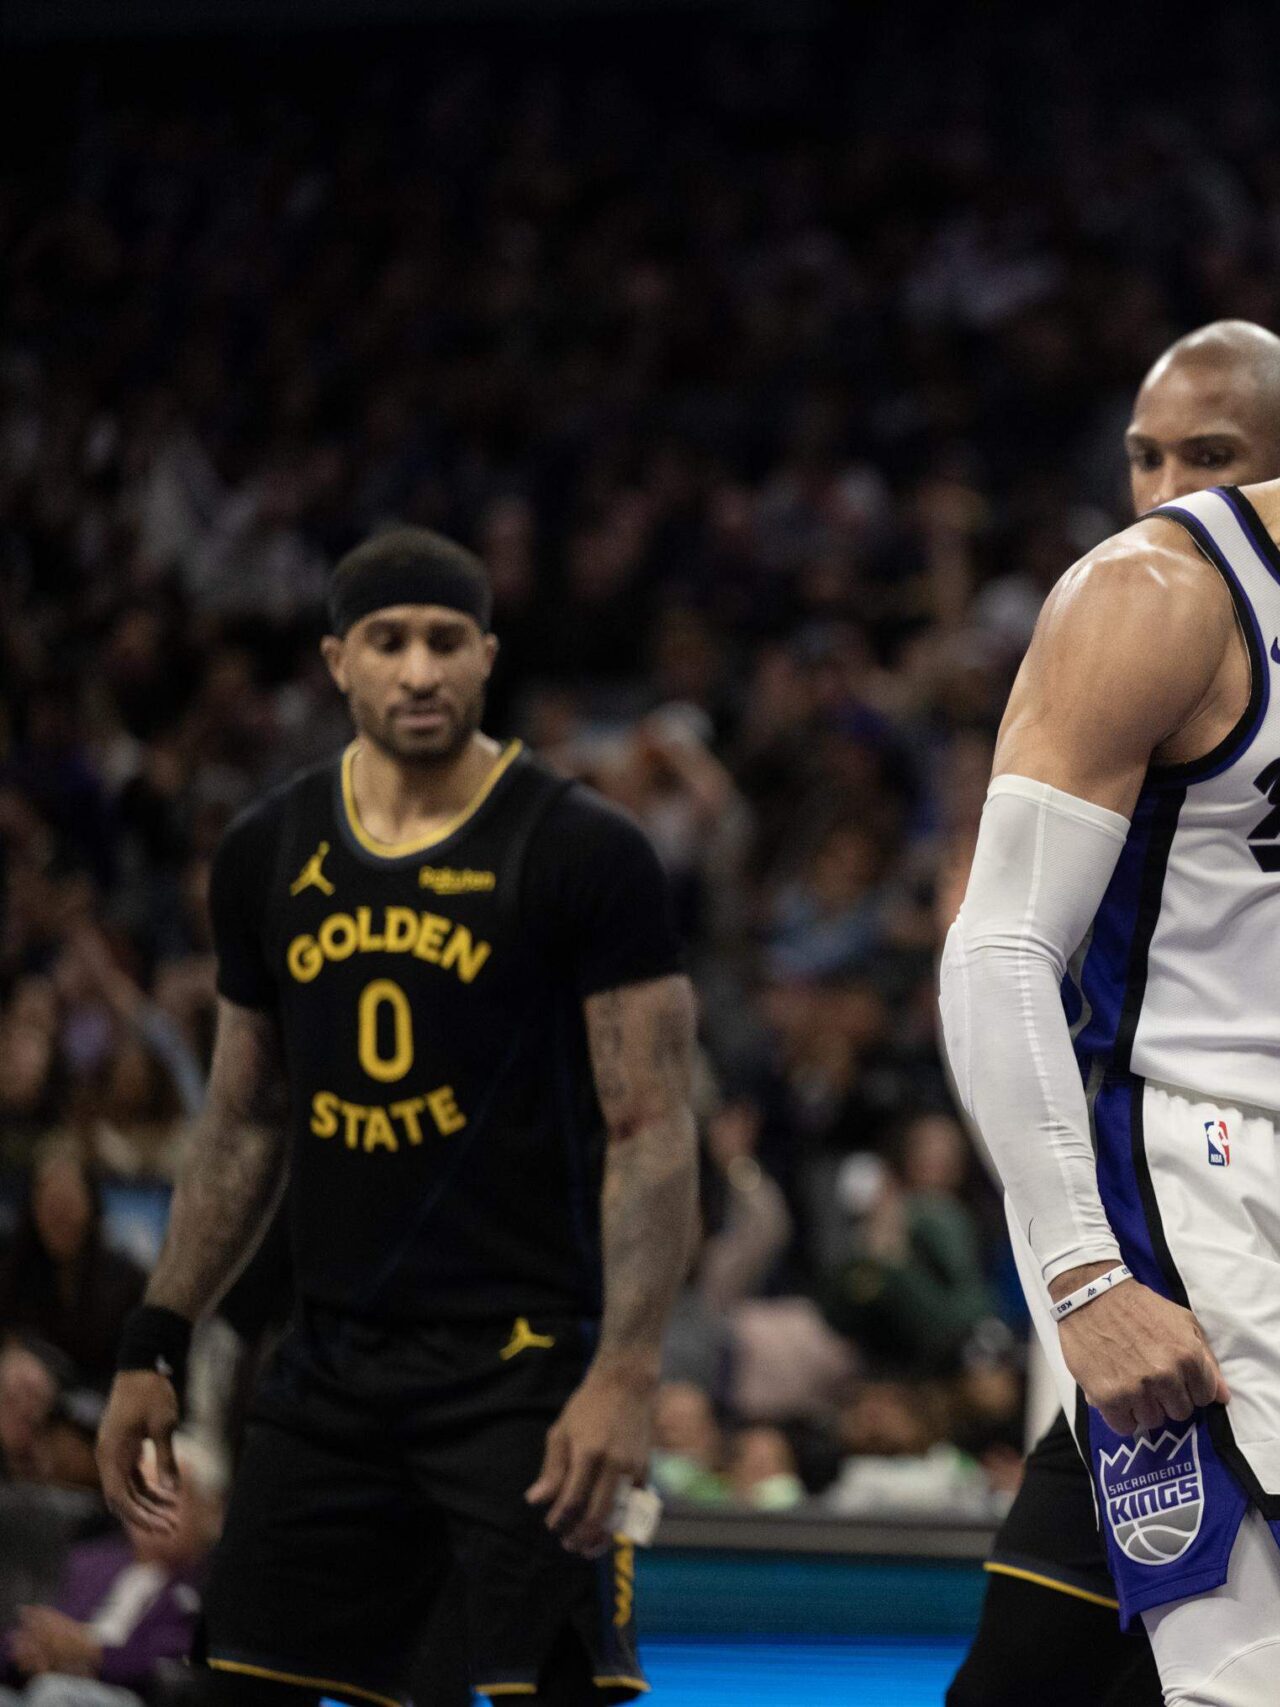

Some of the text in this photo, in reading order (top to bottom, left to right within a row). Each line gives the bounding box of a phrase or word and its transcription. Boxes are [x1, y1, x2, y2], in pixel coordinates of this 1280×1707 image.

[287, 907, 492, 984] GOLDEN
[358, 979, 414, 1083] 0
[311, 1087, 467, 1153] STATE
[1108, 1461, 1192, 1496] SACRAMENTO
[1109, 1476, 1201, 1526] KINGS
